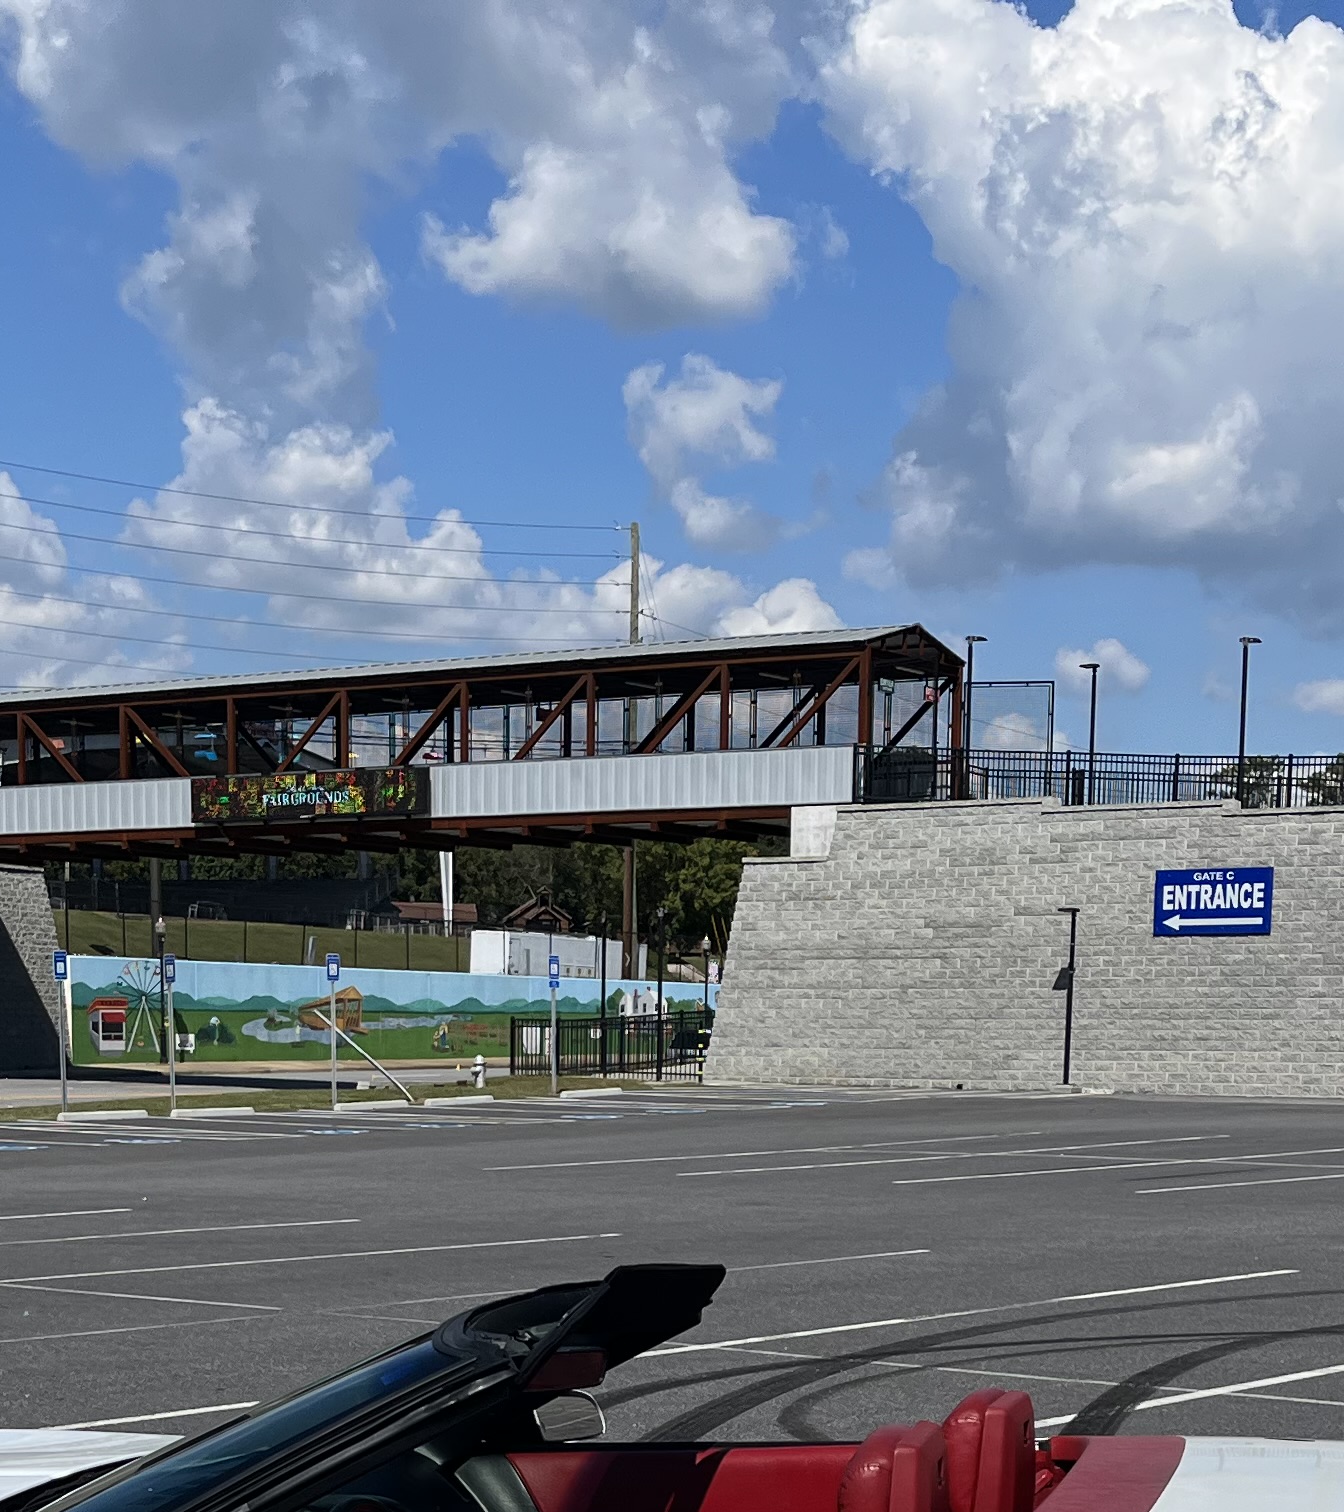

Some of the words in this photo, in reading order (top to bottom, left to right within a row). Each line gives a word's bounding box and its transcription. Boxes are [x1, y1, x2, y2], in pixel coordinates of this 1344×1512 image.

[1193, 872, 1223, 881] GATE
[1226, 871, 1235, 880] C
[1162, 883, 1265, 910] ENTRANCE
